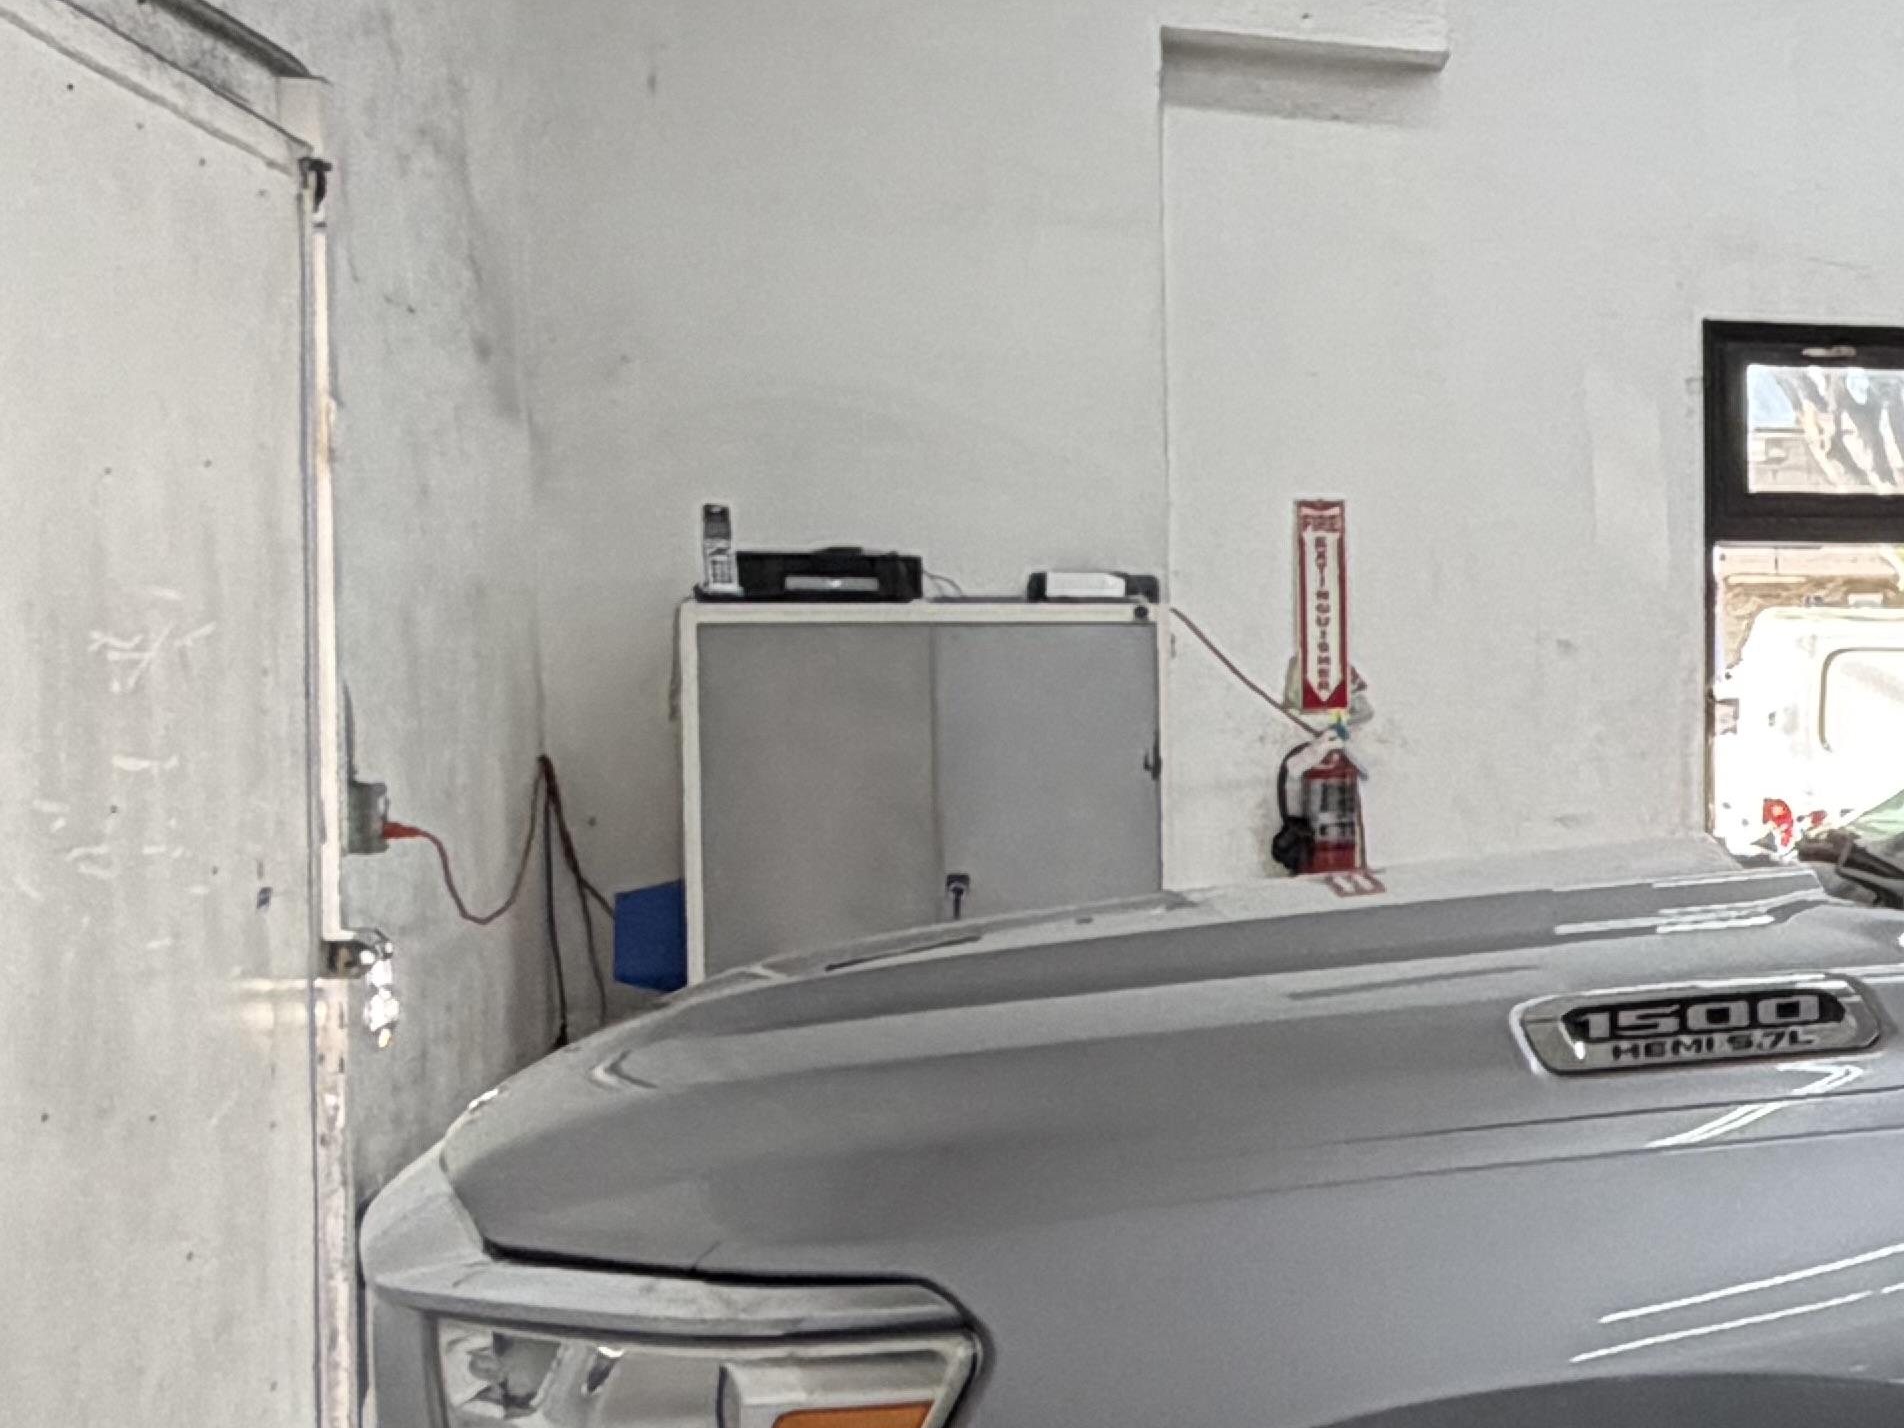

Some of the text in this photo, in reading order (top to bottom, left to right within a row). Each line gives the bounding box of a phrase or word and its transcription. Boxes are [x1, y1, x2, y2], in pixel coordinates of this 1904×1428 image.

[1578, 994, 1821, 1040] 1500
[1612, 1028, 1815, 1060] HEMI 5.7L
